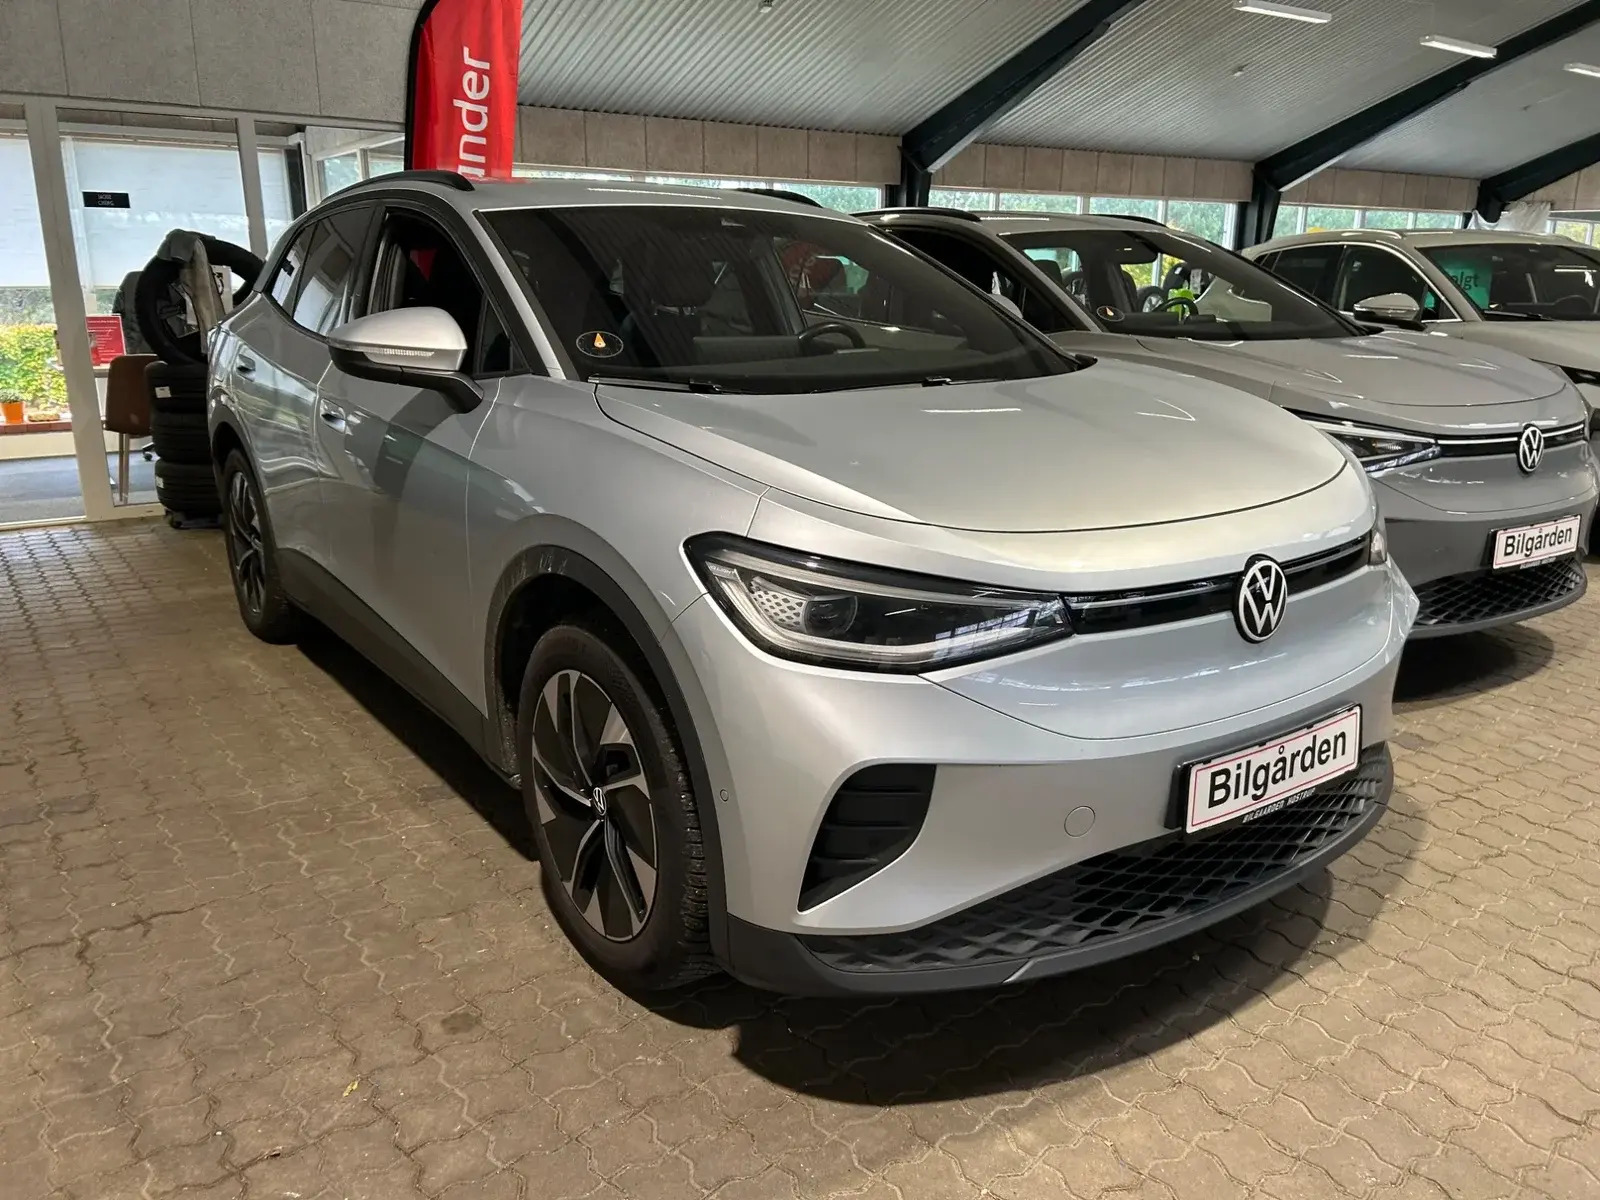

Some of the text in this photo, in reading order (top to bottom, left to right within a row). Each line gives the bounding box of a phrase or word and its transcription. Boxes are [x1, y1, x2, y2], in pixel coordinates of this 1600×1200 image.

[1503, 526, 1572, 557] Bilgården
[1240, 561, 1286, 638] VW
[1208, 730, 1347, 809] Bilgården
